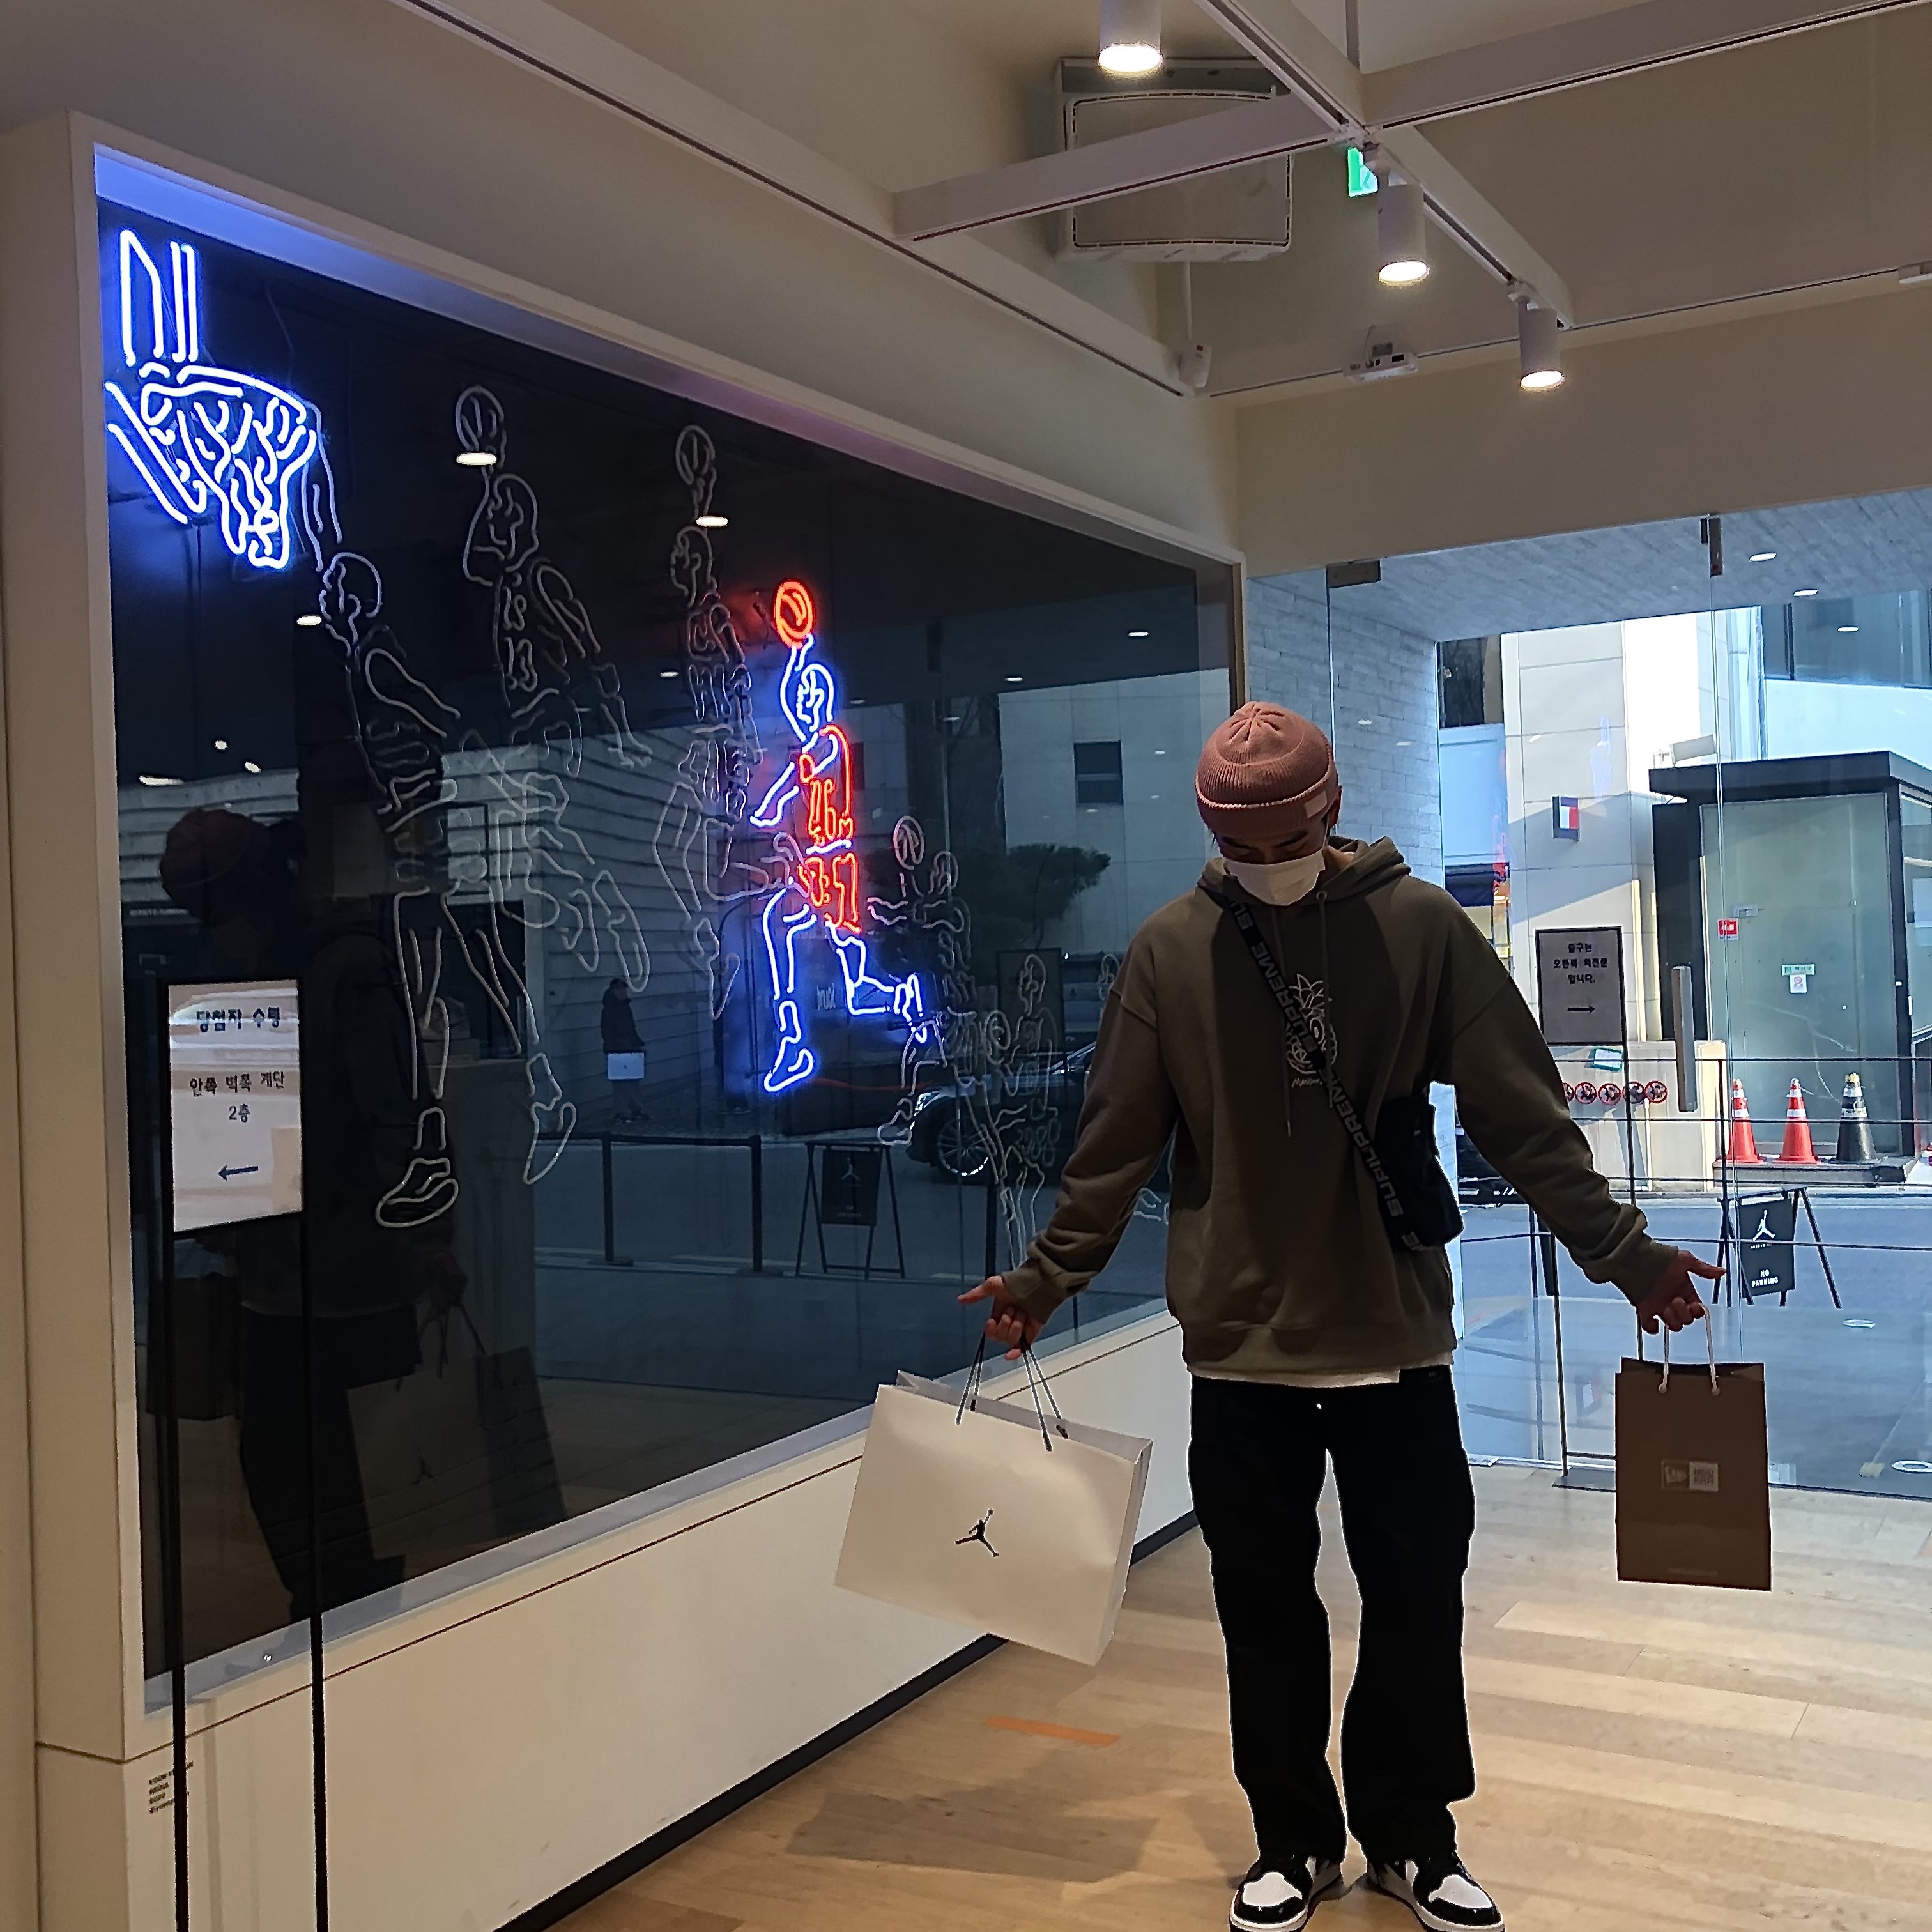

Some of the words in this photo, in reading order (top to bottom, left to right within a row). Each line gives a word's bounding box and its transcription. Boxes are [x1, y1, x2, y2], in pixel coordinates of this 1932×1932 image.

[1251, 941, 1318, 1052] SUPREME
[196, 1009, 243, 1032] 당첨자
[252, 1007, 280, 1028] 수령
[190, 1077, 218, 1097] 안쪽
[226, 1073, 252, 1093] 벽쪽
[260, 1071, 285, 1089] 계단
[229, 1103, 250, 1123] 2층
[1751, 1276, 1778, 1287] PARKING
